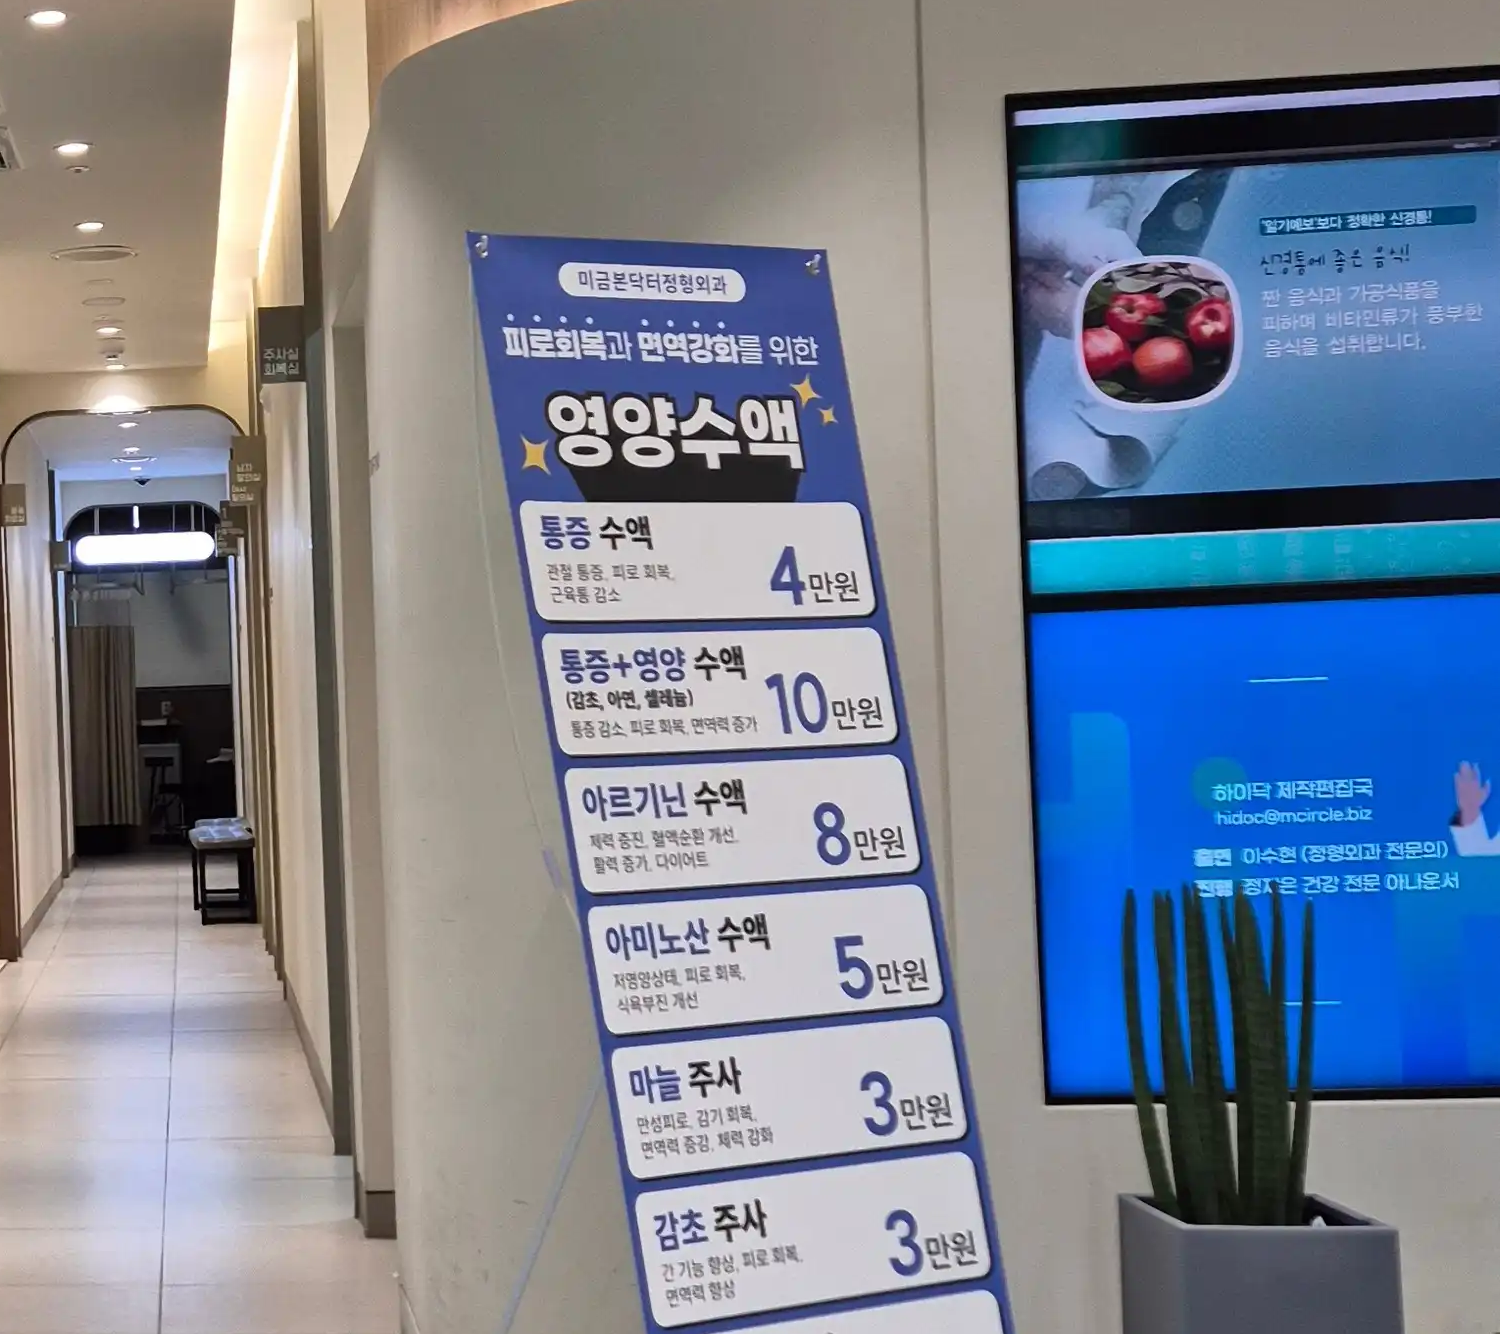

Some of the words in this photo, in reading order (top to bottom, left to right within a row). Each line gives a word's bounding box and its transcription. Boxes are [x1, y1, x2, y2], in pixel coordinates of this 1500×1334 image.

[1347, 212, 1386, 229] 정확한
[1391, 209, 1432, 226] 신경통!
[1261, 250, 1326, 276] 신경통에
[1332, 248, 1362, 274] 좋은
[1372, 244, 1411, 269] 음식!
[578, 270, 728, 296] 미금본닥터정형외과
[1262, 288, 1281, 308] 짠
[1287, 286, 1343, 307] 음식과
[1349, 279, 1440, 302] 가공식품을
[1263, 312, 1316, 333] 피하며
[1325, 306, 1418, 329] 비타민류가
[1426, 303, 1484, 325] 풍부한
[263, 347, 299, 361] 주사실
[502, 326, 633, 361] 피로회복과
[637, 330, 764, 365] 면역강화를
[769, 334, 820, 366] 위한
[1264, 337, 1318, 358] 음식을
[1327, 332, 1427, 355] 섭취합니다.
[263, 362, 300, 376] 회복실
[546, 393, 805, 471] 영양수액
[540, 515, 591, 551] 통증
[598, 515, 654, 551] 수액
[612, 563, 640, 581] 피로
[771, 546, 860, 606] 4만원
[551, 586, 590, 604] 근육통
[593, 586, 622, 604] 감소
[560, 646, 687, 685] 통증+영양
[694, 645, 748, 682] 수액
[566, 690, 604, 711] (감초,
[607, 689, 641, 711] 아연,
[644, 688, 694, 709] 셀레늄)
[764, 671, 884, 735] 10만원
[570, 720, 596, 740] 통증
[630, 719, 657, 737] 피로
[691, 716, 730, 735] 면역력
[732, 715, 758, 734] 증가
[582, 781, 689, 822] 아르기닌
[694, 778, 748, 817] 수액
[1212, 783, 1273, 803] 하이닥
[1277, 778, 1373, 799] 제작편집국
[1215, 806, 1373, 826] hidoc@mcircle.biz
[651, 828, 705, 849] 혈액순환
[813, 802, 907, 866] 8만원
[655, 851, 709, 872] 다이어트
[1241, 846, 1297, 865] 이수현
[1301, 843, 1381, 865] (정형외과
[1386, 840, 1449, 861] 전문의)
[1302, 875, 1338, 894] 건강
[1343, 873, 1380, 893] 전문
[1385, 871, 1460, 892] 아나운서
[605, 917, 711, 961] 아미노산
[718, 913, 771, 953] 수액
[685, 966, 712, 985] 피로
[834, 935, 930, 1000] 5만원
[617, 993, 669, 1015] 식욕부진
[672, 991, 700, 1010] 개선
[629, 1064, 682, 1104] 마늘
[688, 1056, 742, 1098] 주사
[697, 1108, 724, 1128] 감기
[859, 1070, 955, 1137] 3만원
[641, 1138, 681, 1160] 면역력
[747, 1126, 774, 1147] 강화
[653, 1208, 709, 1252] 감초
[713, 1198, 768, 1243] 주사
[884, 1209, 978, 1277] 3만원
[661, 1263, 675, 1283] 간
[678, 1259, 706, 1279] 기능
[742, 1249, 770, 1269] 피로
[666, 1284, 706, 1309] 면역력
[708, 1279, 736, 1302] 향상
